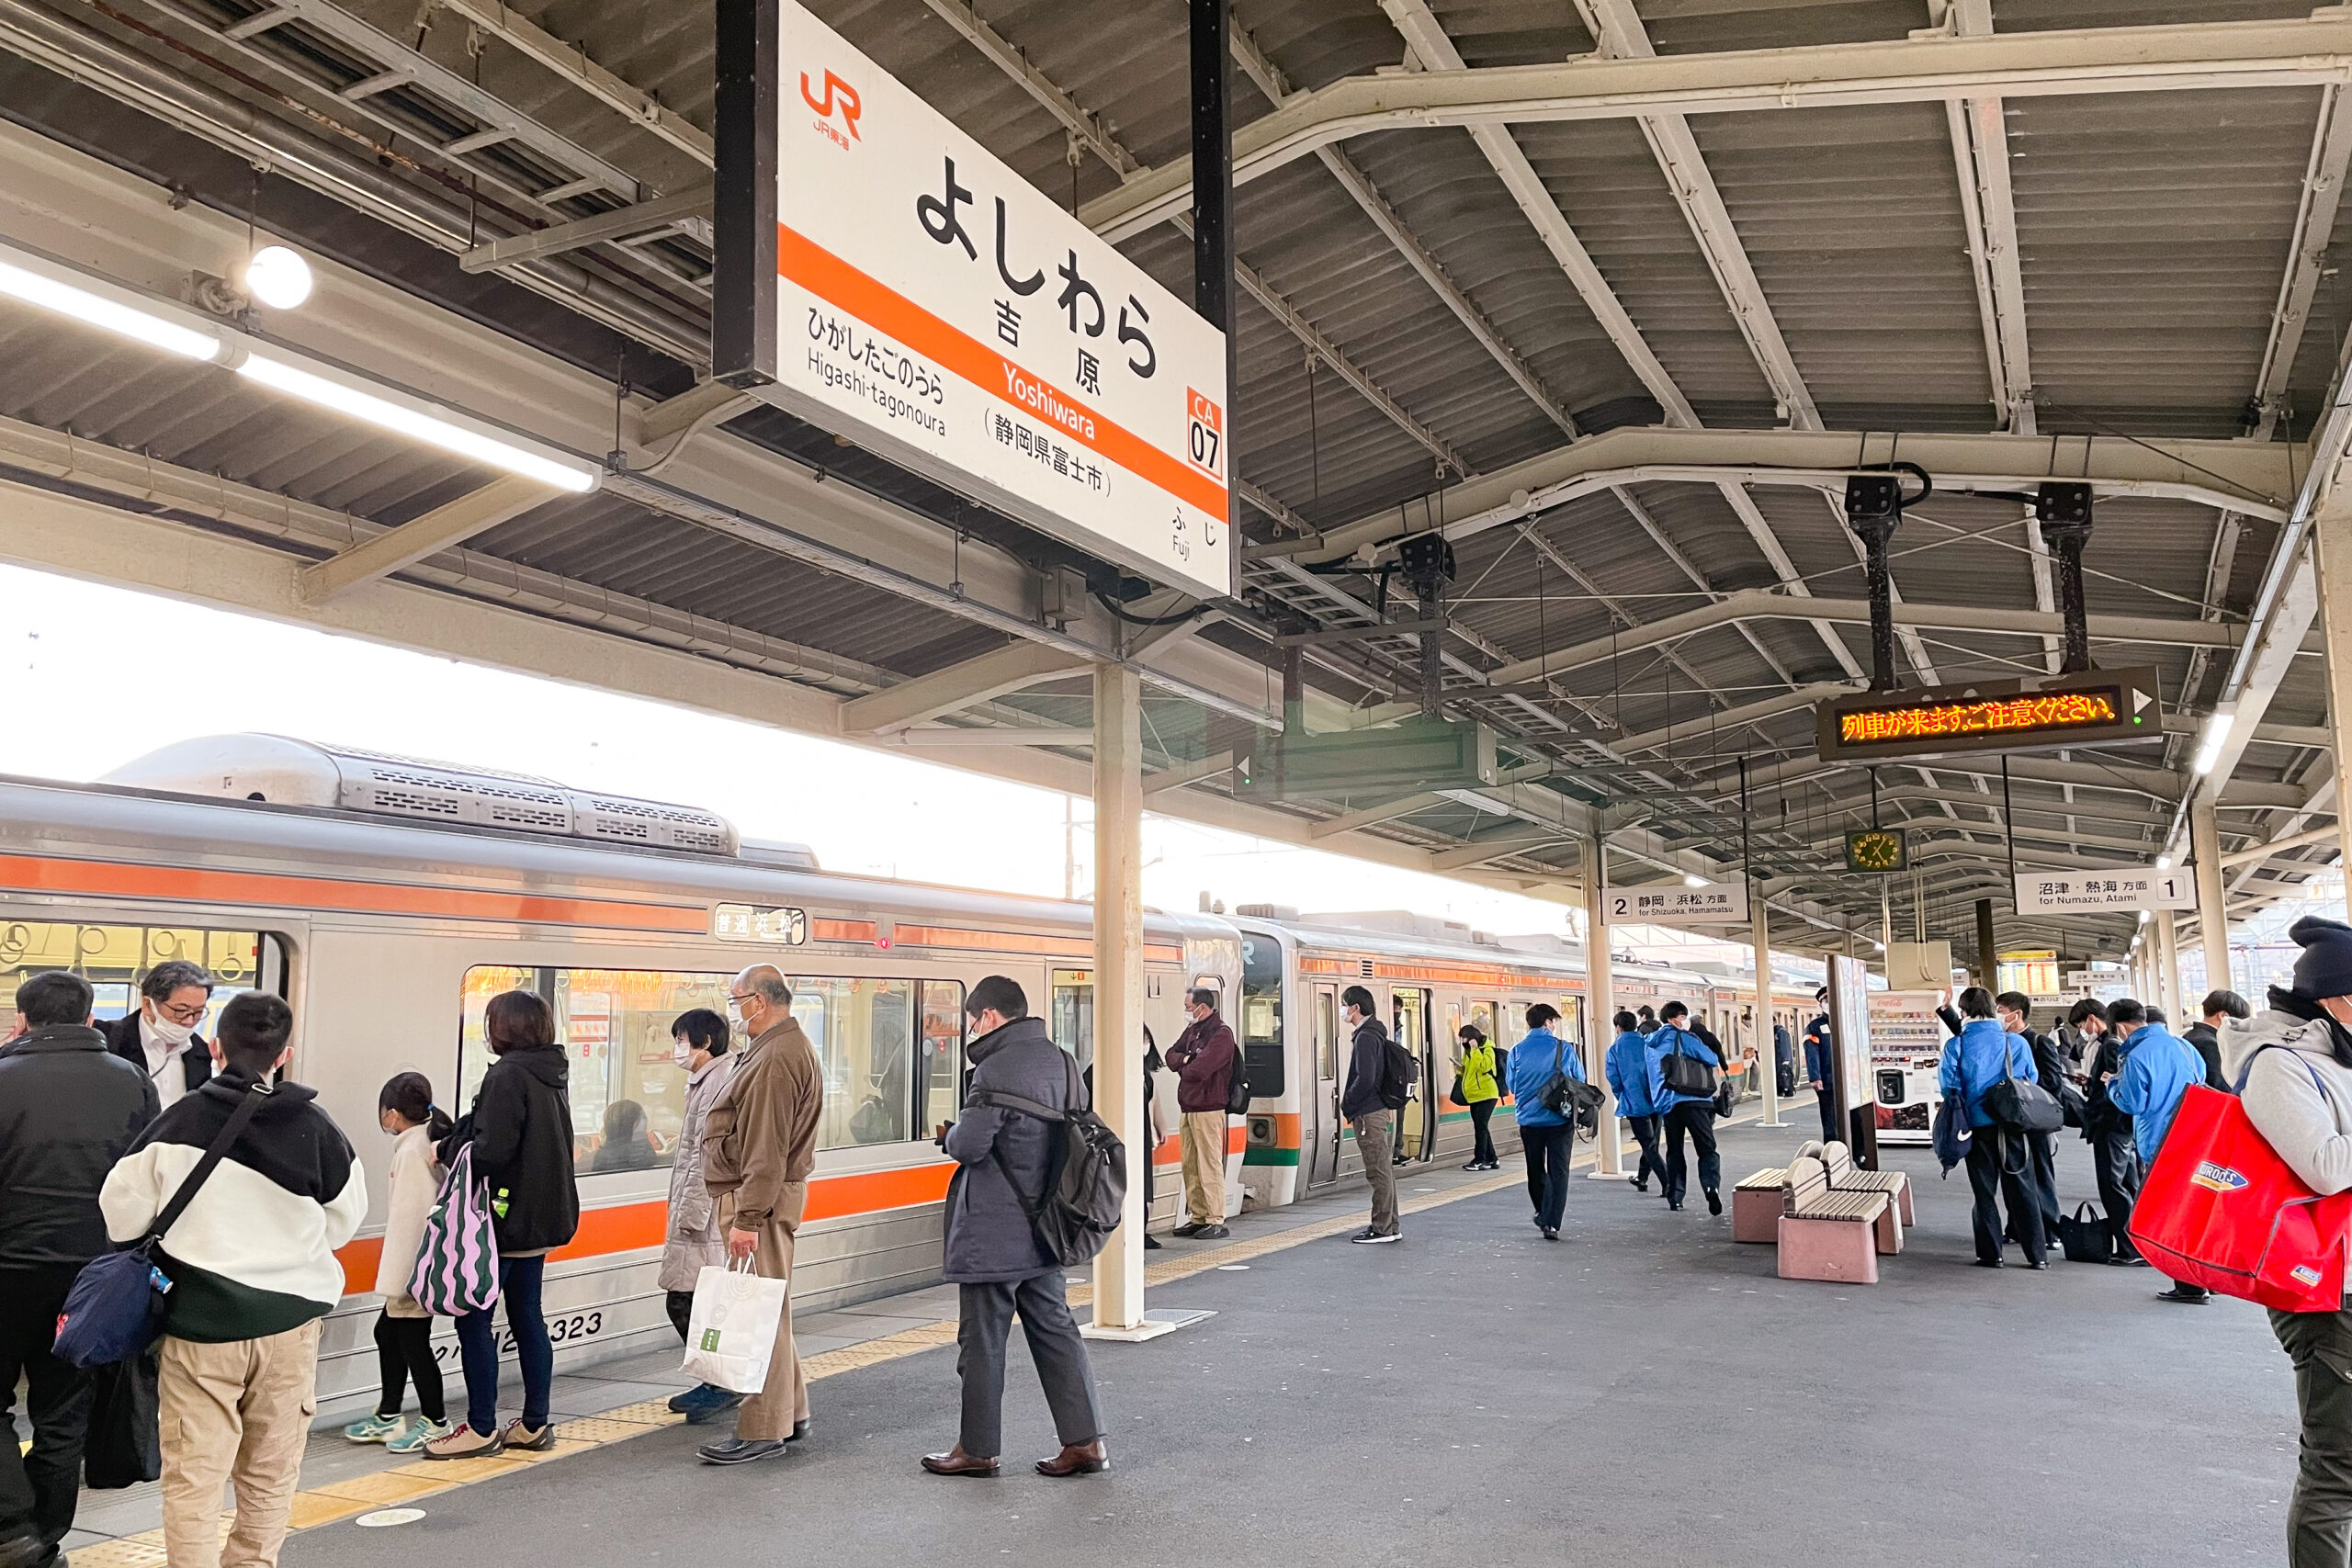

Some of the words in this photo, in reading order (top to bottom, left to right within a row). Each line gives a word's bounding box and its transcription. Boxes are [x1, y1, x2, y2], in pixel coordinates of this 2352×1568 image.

[800, 67, 862, 142] JR
[812, 118, 850, 152] JR東海
[916, 155, 1157, 379] よしわら
[808, 307, 944, 405] ひがしたごのうら
[993, 299, 1102, 398] 吉原
[808, 347, 946, 438] Higashi-tagonoura
[1002, 362, 1095, 441] Yoshiwara
[1193, 396, 1216, 425] CA
[1190, 422, 1219, 469] 07
[1171, 507, 1217, 547] ふじ
[1172, 536, 1191, 561] Fuji
[1706, 894, 1727, 904] 方面
[2039, 897, 2054, 906] for
[2057, 896, 2104, 906] Numazu,
[2106, 893, 2137, 903] Atami
[2122, 880, 2148, 891] 方面
[2164, 879, 2175, 897] 1
[1614, 898, 1628, 915] 2
[1638, 908, 1650, 917] for
[1689, 906, 1734, 914] Hamamatsu
